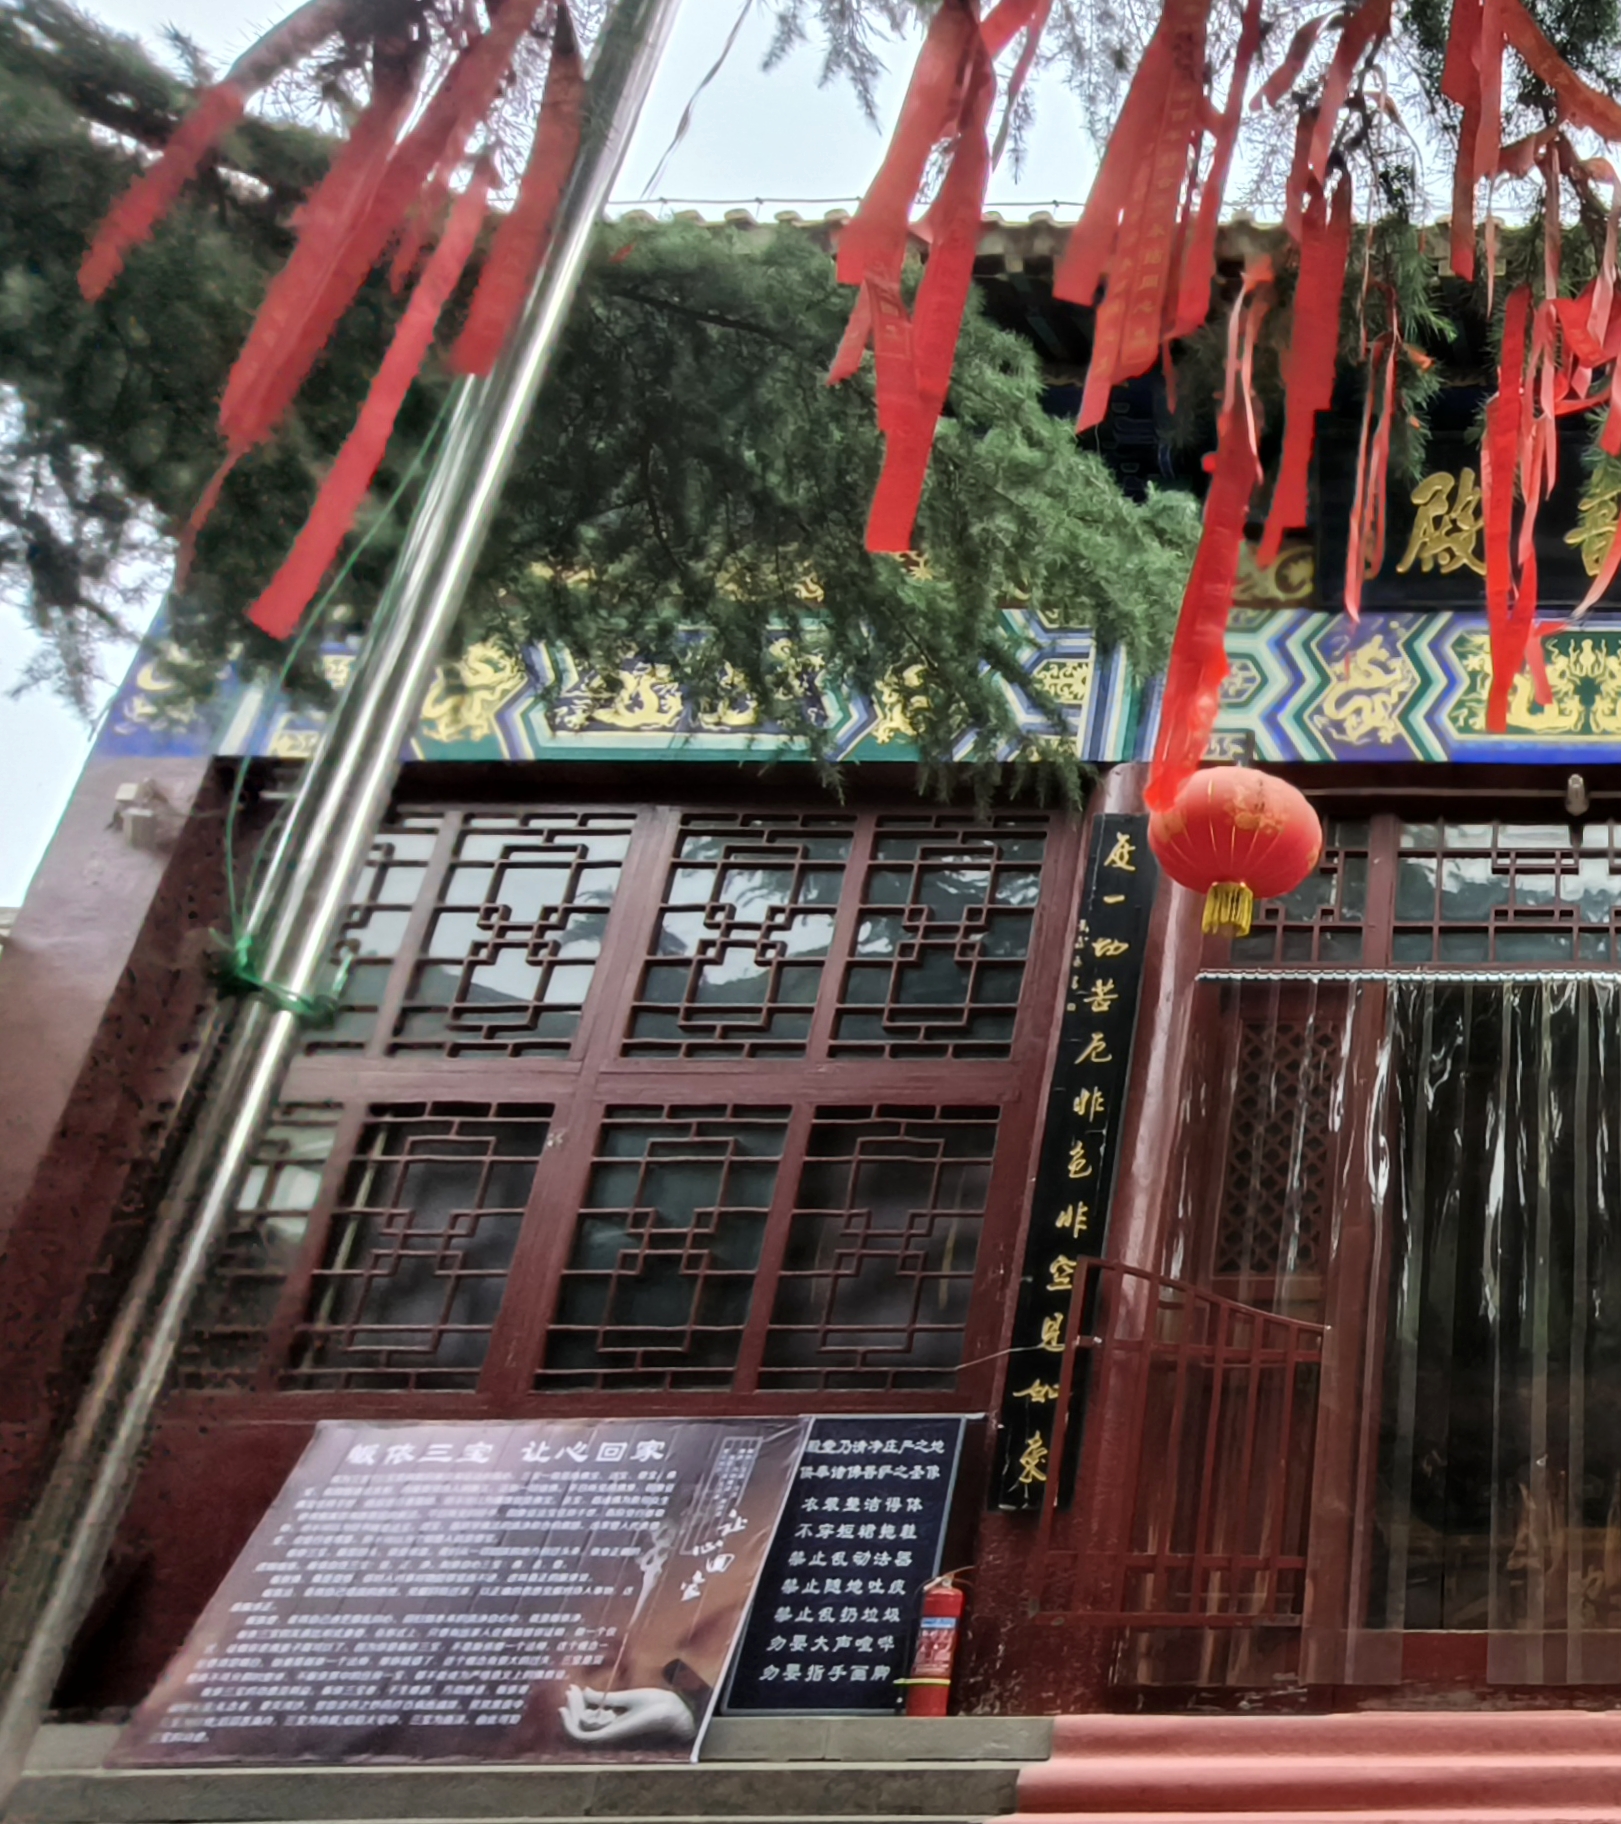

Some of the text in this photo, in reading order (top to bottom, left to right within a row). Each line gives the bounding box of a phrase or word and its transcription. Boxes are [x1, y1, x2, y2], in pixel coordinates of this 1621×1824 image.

[520, 1440, 666, 1463] 让心回家
[794, 1523, 918, 1540] 不穿短裙拖鞋
[788, 1550, 913, 1567] 禁止乱动法器
[781, 1577, 907, 1595] 禁止随地吐痰
[774, 1606, 901, 1623] 禁止乱扔垃圾
[766, 1634, 895, 1653] 勿要大声喧哗
[758, 1663, 892, 1682] 勿要指手画脚
